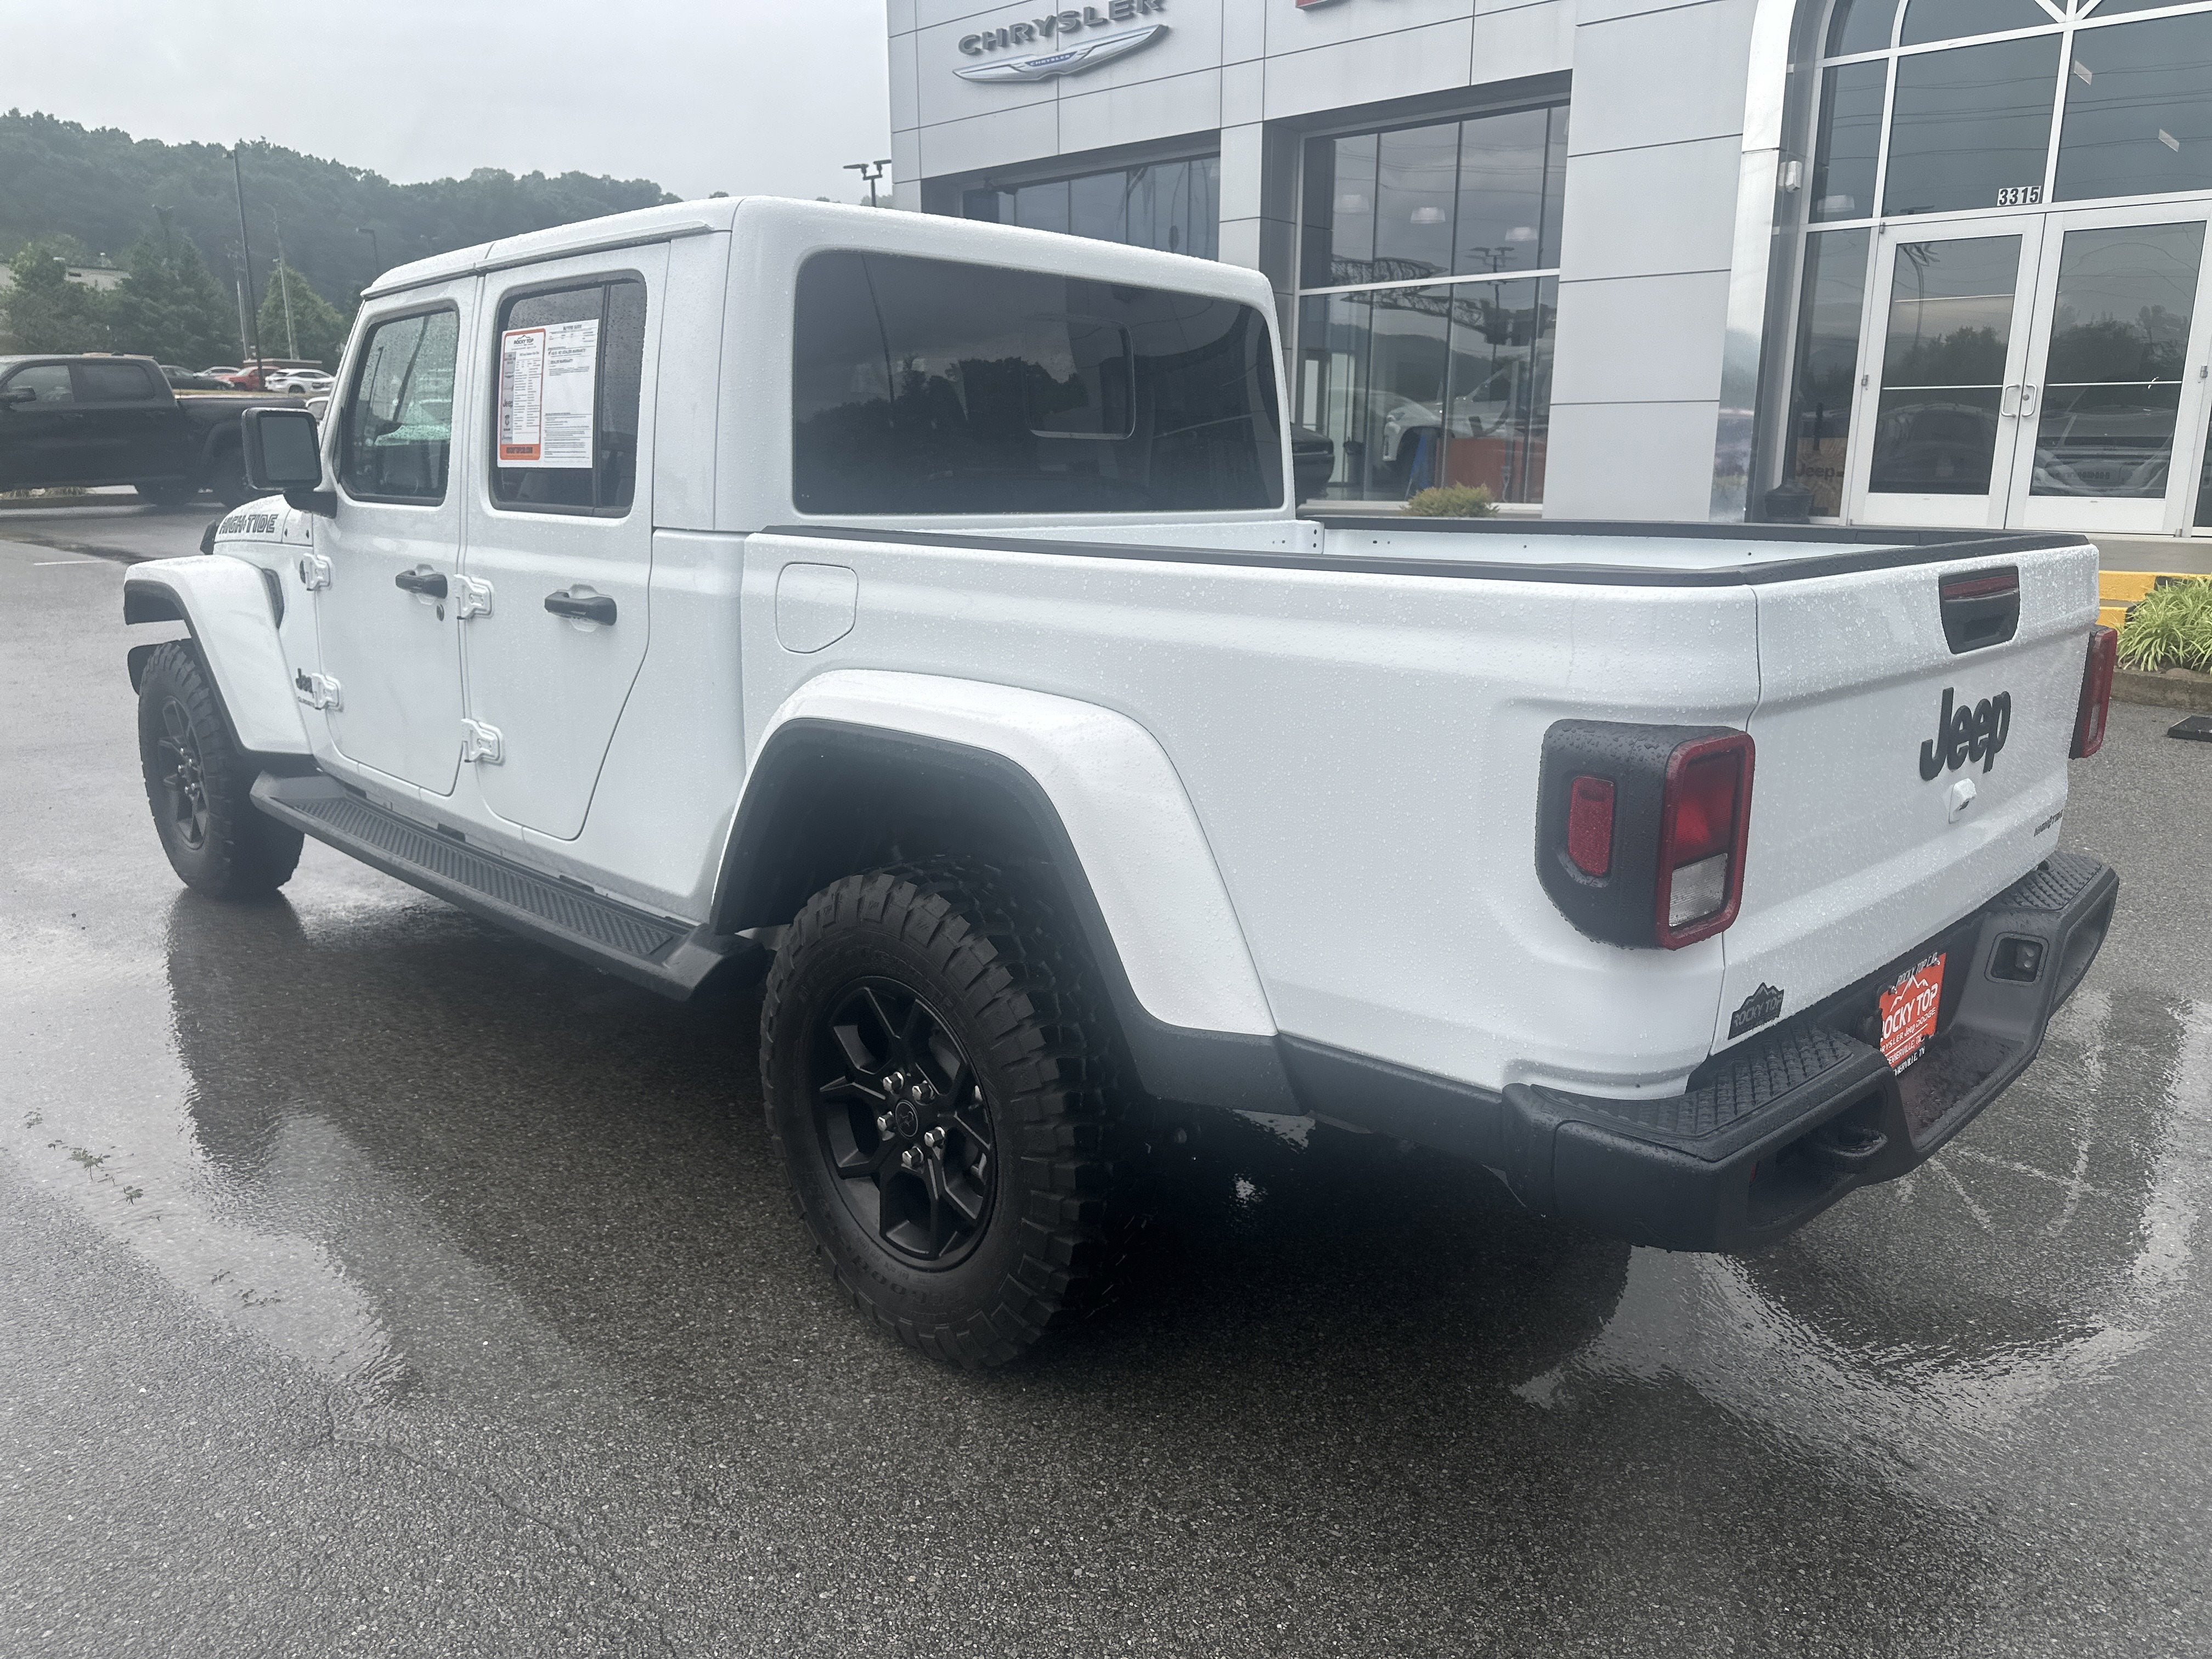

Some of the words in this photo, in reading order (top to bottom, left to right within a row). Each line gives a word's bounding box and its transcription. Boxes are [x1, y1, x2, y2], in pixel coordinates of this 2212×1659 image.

[958, 0, 1162, 55] CHRYSLER
[1999, 187, 2039, 205] 3315
[246, 514, 279, 533] TIDE
[1920, 687, 2011, 781] Jeep
[1734, 1000, 1765, 1028] ROCKY
[1881, 998, 1915, 1042] OCKY
[1917, 983, 1938, 1015] TOP
[1904, 1024, 1915, 1037] Jeep
[1916, 1007, 1936, 1028] DODGE
